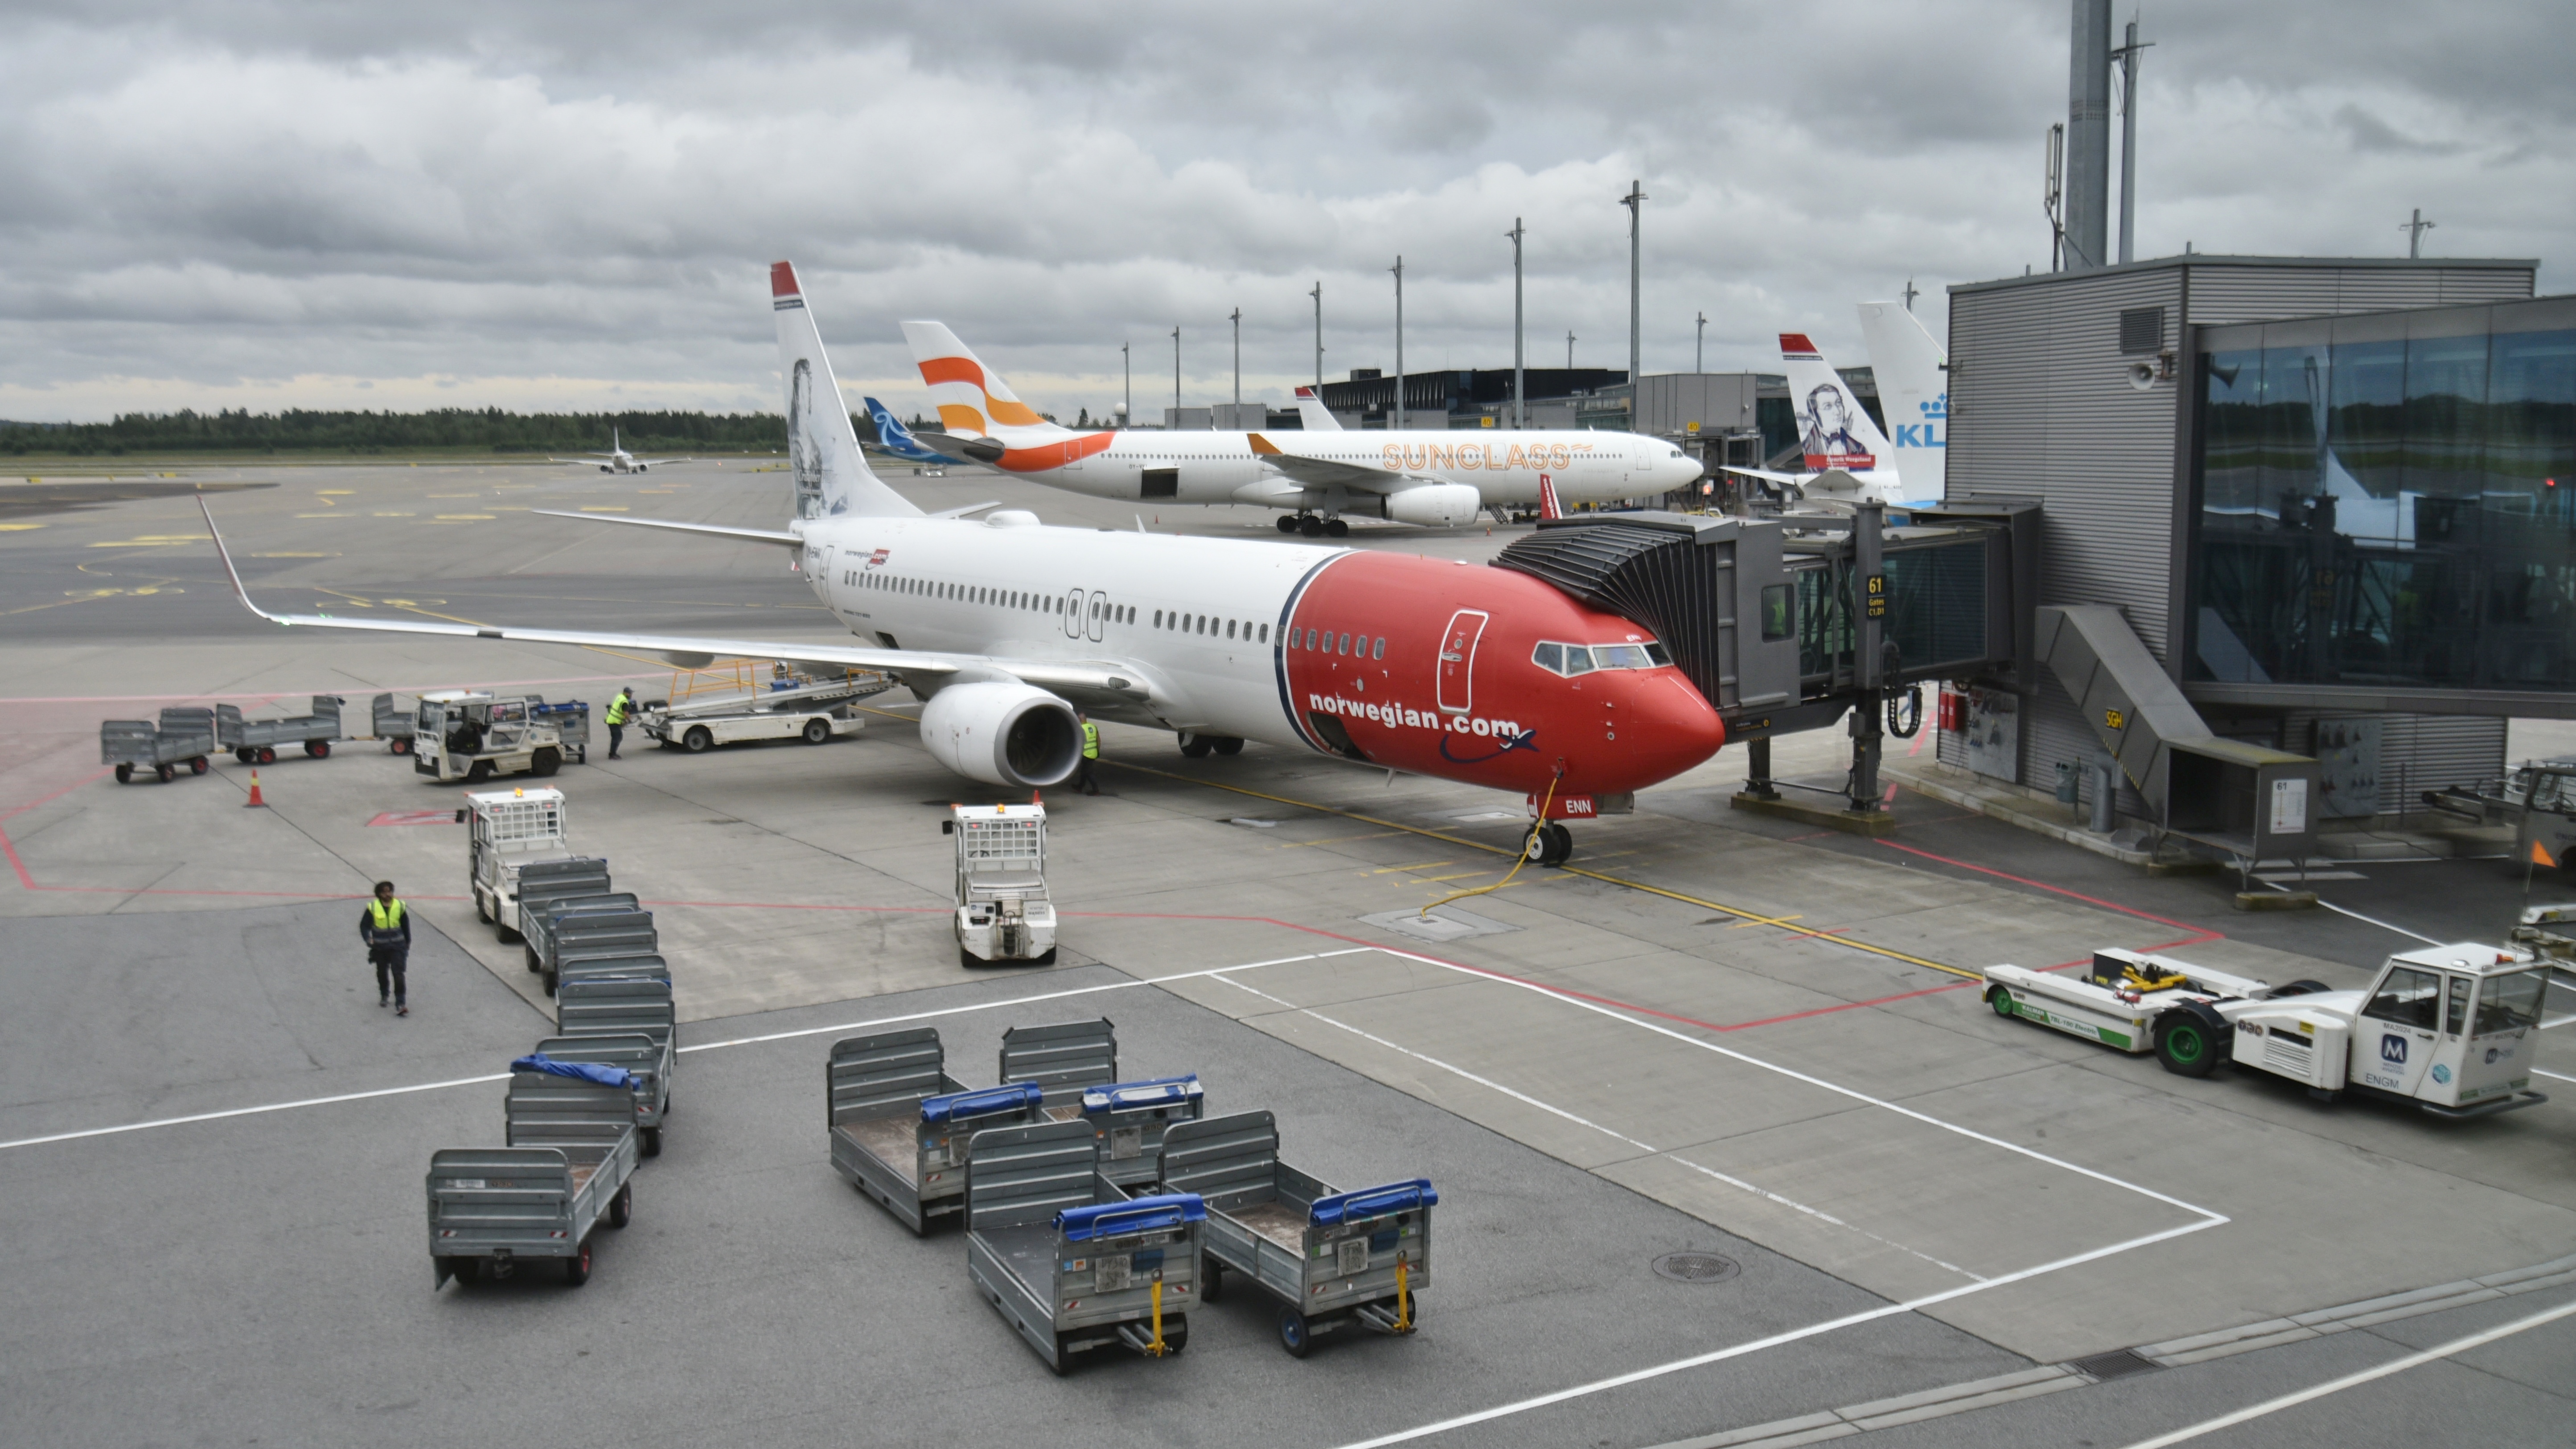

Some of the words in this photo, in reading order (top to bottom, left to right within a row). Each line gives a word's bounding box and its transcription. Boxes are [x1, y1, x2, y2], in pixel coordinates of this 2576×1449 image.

[1383, 444, 1569, 470] SUNCLASS
[1543, 478, 1555, 520] norwegian
[1869, 577, 1882, 593] 61
[1869, 598, 1884, 606] Gates
[2107, 711, 2122, 729] SGH
[2277, 782, 2287, 791] 61
[1565, 799, 1592, 813] ENN
[2022, 1005, 2044, 1017] KALMAR
[2075, 1022, 2097, 1035] Electric
[2383, 1022, 2412, 1034] MA2024
[2366, 1073, 2399, 1089] ENGM
